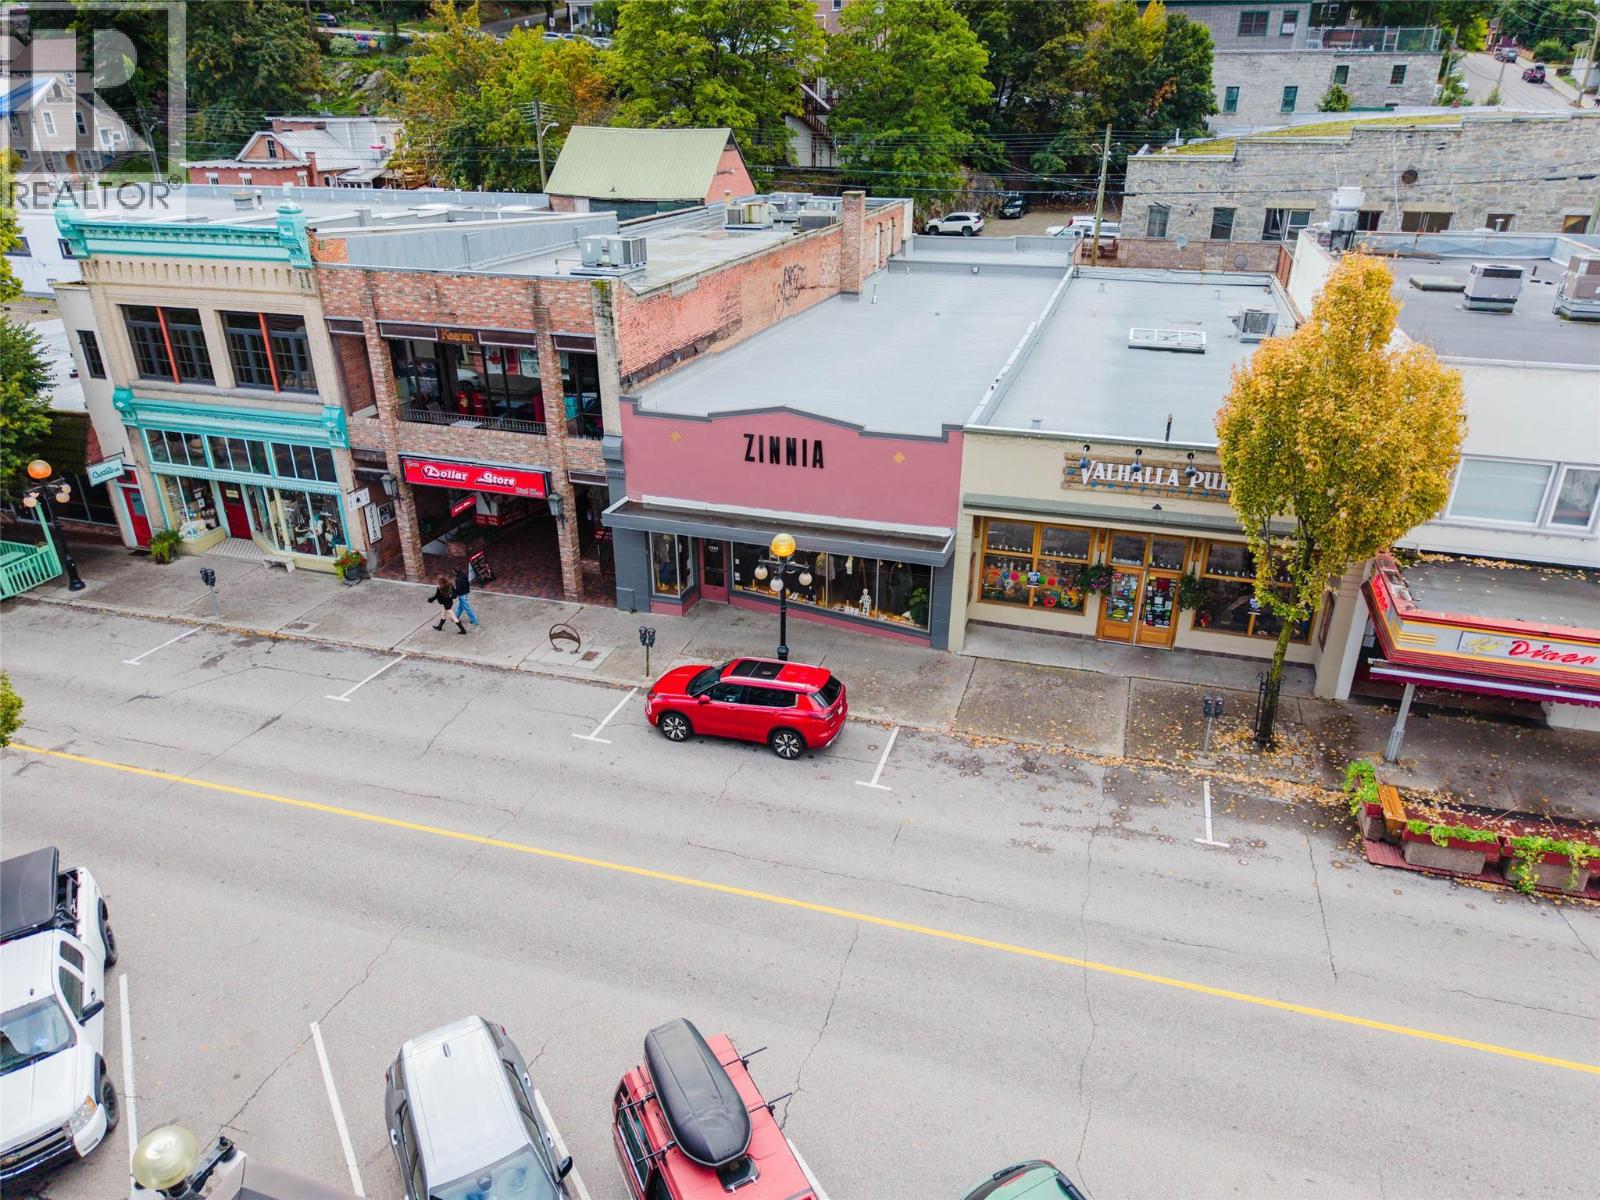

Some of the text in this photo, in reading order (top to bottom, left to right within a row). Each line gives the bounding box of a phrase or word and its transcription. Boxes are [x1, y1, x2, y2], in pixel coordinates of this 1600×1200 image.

[743, 433, 824, 469] ZINNIA
[422, 464, 468, 482] Dollar
[475, 470, 516, 487] Store
[1081, 460, 1180, 487] VALHALLA
[1508, 640, 1597, 665] Diner
